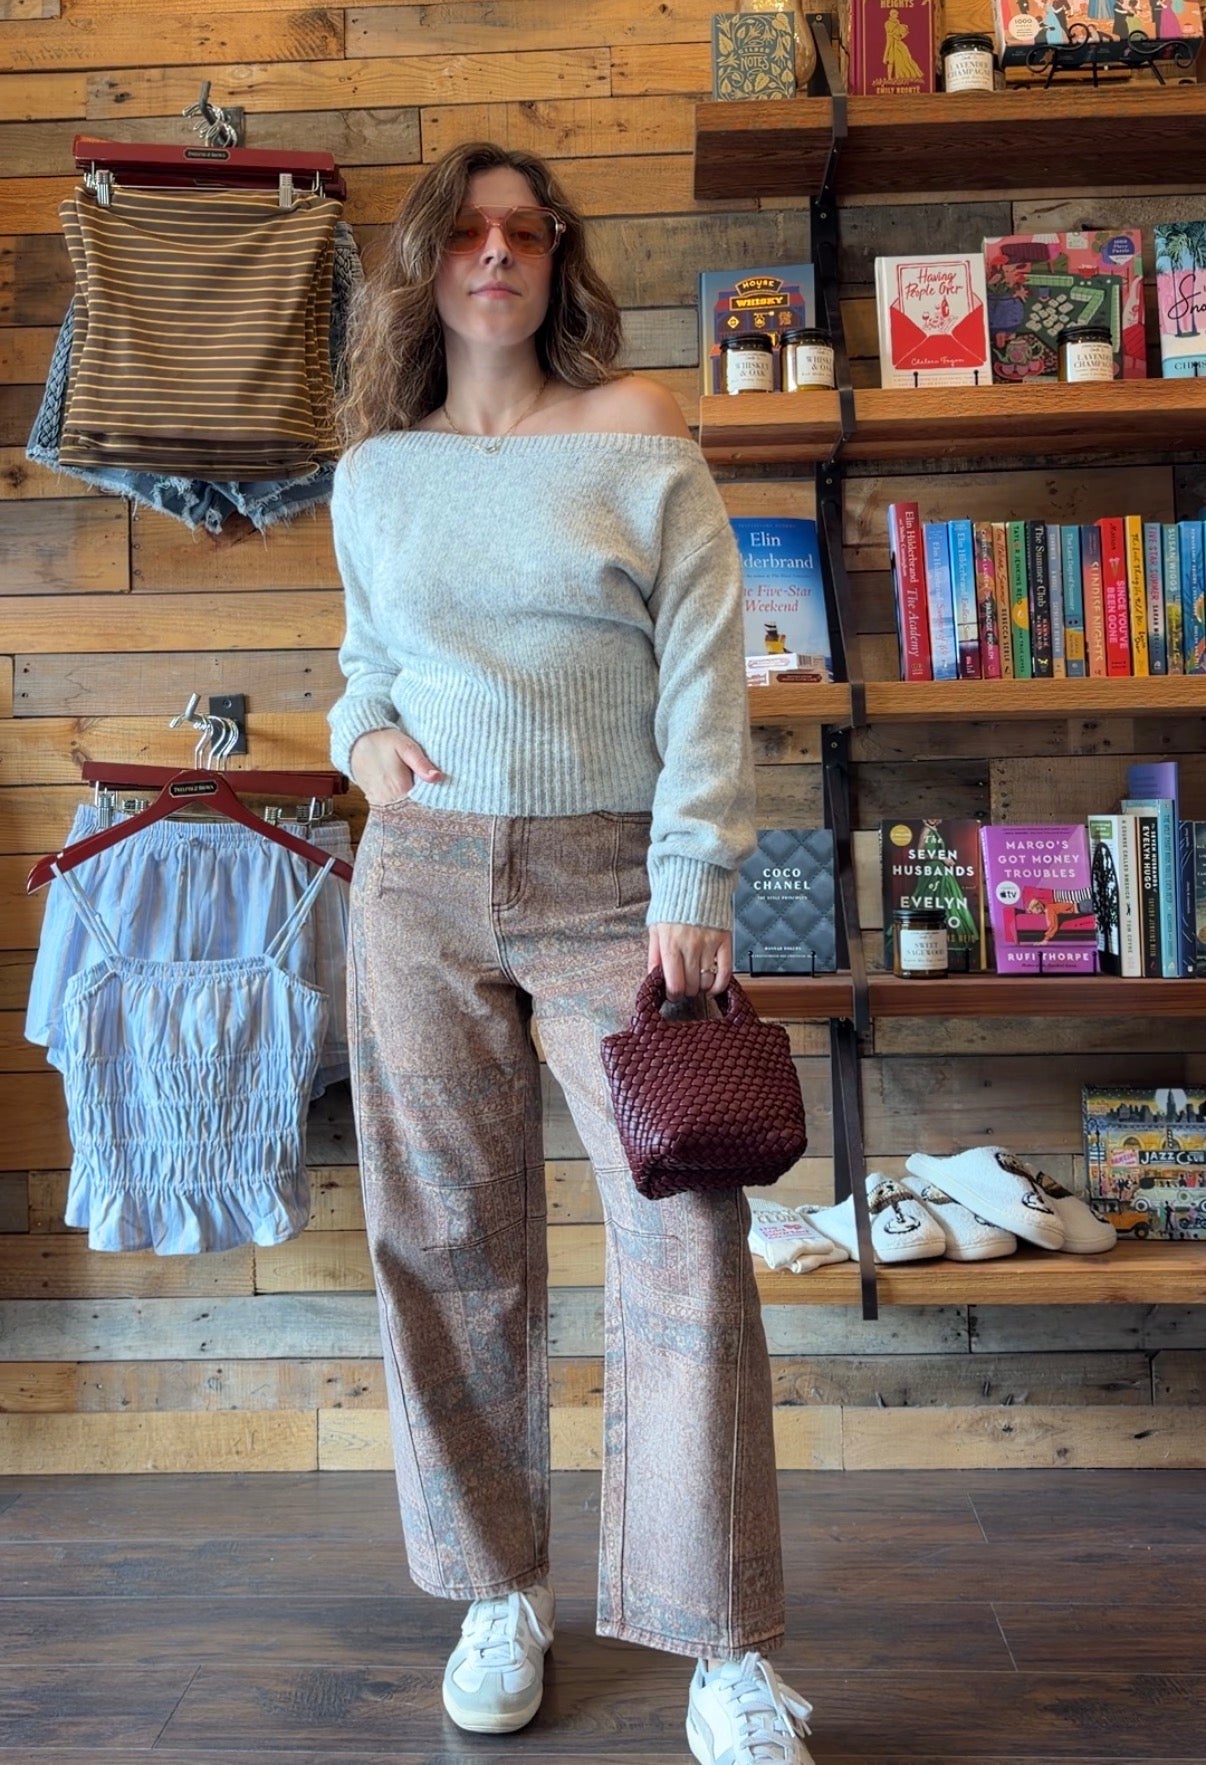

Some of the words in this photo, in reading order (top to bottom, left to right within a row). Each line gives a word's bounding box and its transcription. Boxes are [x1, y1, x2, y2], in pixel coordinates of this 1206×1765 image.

[741, 55, 769, 70] NOTES
[917, 266, 957, 284] Having
[742, 280, 775, 289] HOUSE
[904, 282, 936, 300] People
[938, 282, 964, 295] Over
[735, 296, 784, 307] WHISKY
[748, 369, 766, 377] OAK
[904, 511, 914, 529] Elin
[750, 531, 782, 547] Elin
[1035, 526, 1045, 543] The
[1066, 533, 1074, 547] The
[1168, 528, 1176, 558] SUSAN
[907, 530, 919, 583] Hilderbrand
[1149, 545, 1158, 565] STAR
[1014, 556, 1022, 586] JENKINS
[1035, 545, 1046, 583] Summer
[1150, 569, 1159, 601] SUMMER
[1169, 562, 1177, 592] WIGGS
[757, 584, 812, 597] Five-Star
[907, 588, 919, 609] The
[1036, 585, 1046, 608] Club
[1068, 583, 1076, 610] Summer
[1117, 580, 1127, 610] SINCE
[745, 599, 799, 613] Weekend
[1106, 587, 1116, 613] BEEN
[1001, 608, 1009, 639] REBECCA
[1108, 615, 1118, 643] GONE
[1118, 611, 1128, 649] YOU'VE
[908, 611, 921, 657] Academy
[1092, 616, 1103, 661] NIGHTS
[924, 835, 943, 844] The
[1005, 840, 1069, 850] MARGO'S
[1142, 826, 1150, 860] EVELYN
[908, 849, 958, 860] SEVEN
[998, 855, 1026, 864] GOT
[1031, 854, 1080, 864] MONEY
[762, 868, 801, 878] COCO
[892, 865, 975, 876] HUSBANDS
[1003, 869, 1076, 878] TROUBLES
[1143, 862, 1151, 890] HUGO
[753, 880, 811, 890] CHANEL
[928, 880, 940, 891] of
[900, 896, 968, 909] EVELYN
[1006, 890, 1017, 898] tv
[1007, 952, 1036, 961] RUFI
[1042, 952, 1090, 961] THORPE
[1141, 1151, 1176, 1164] JAZZ
